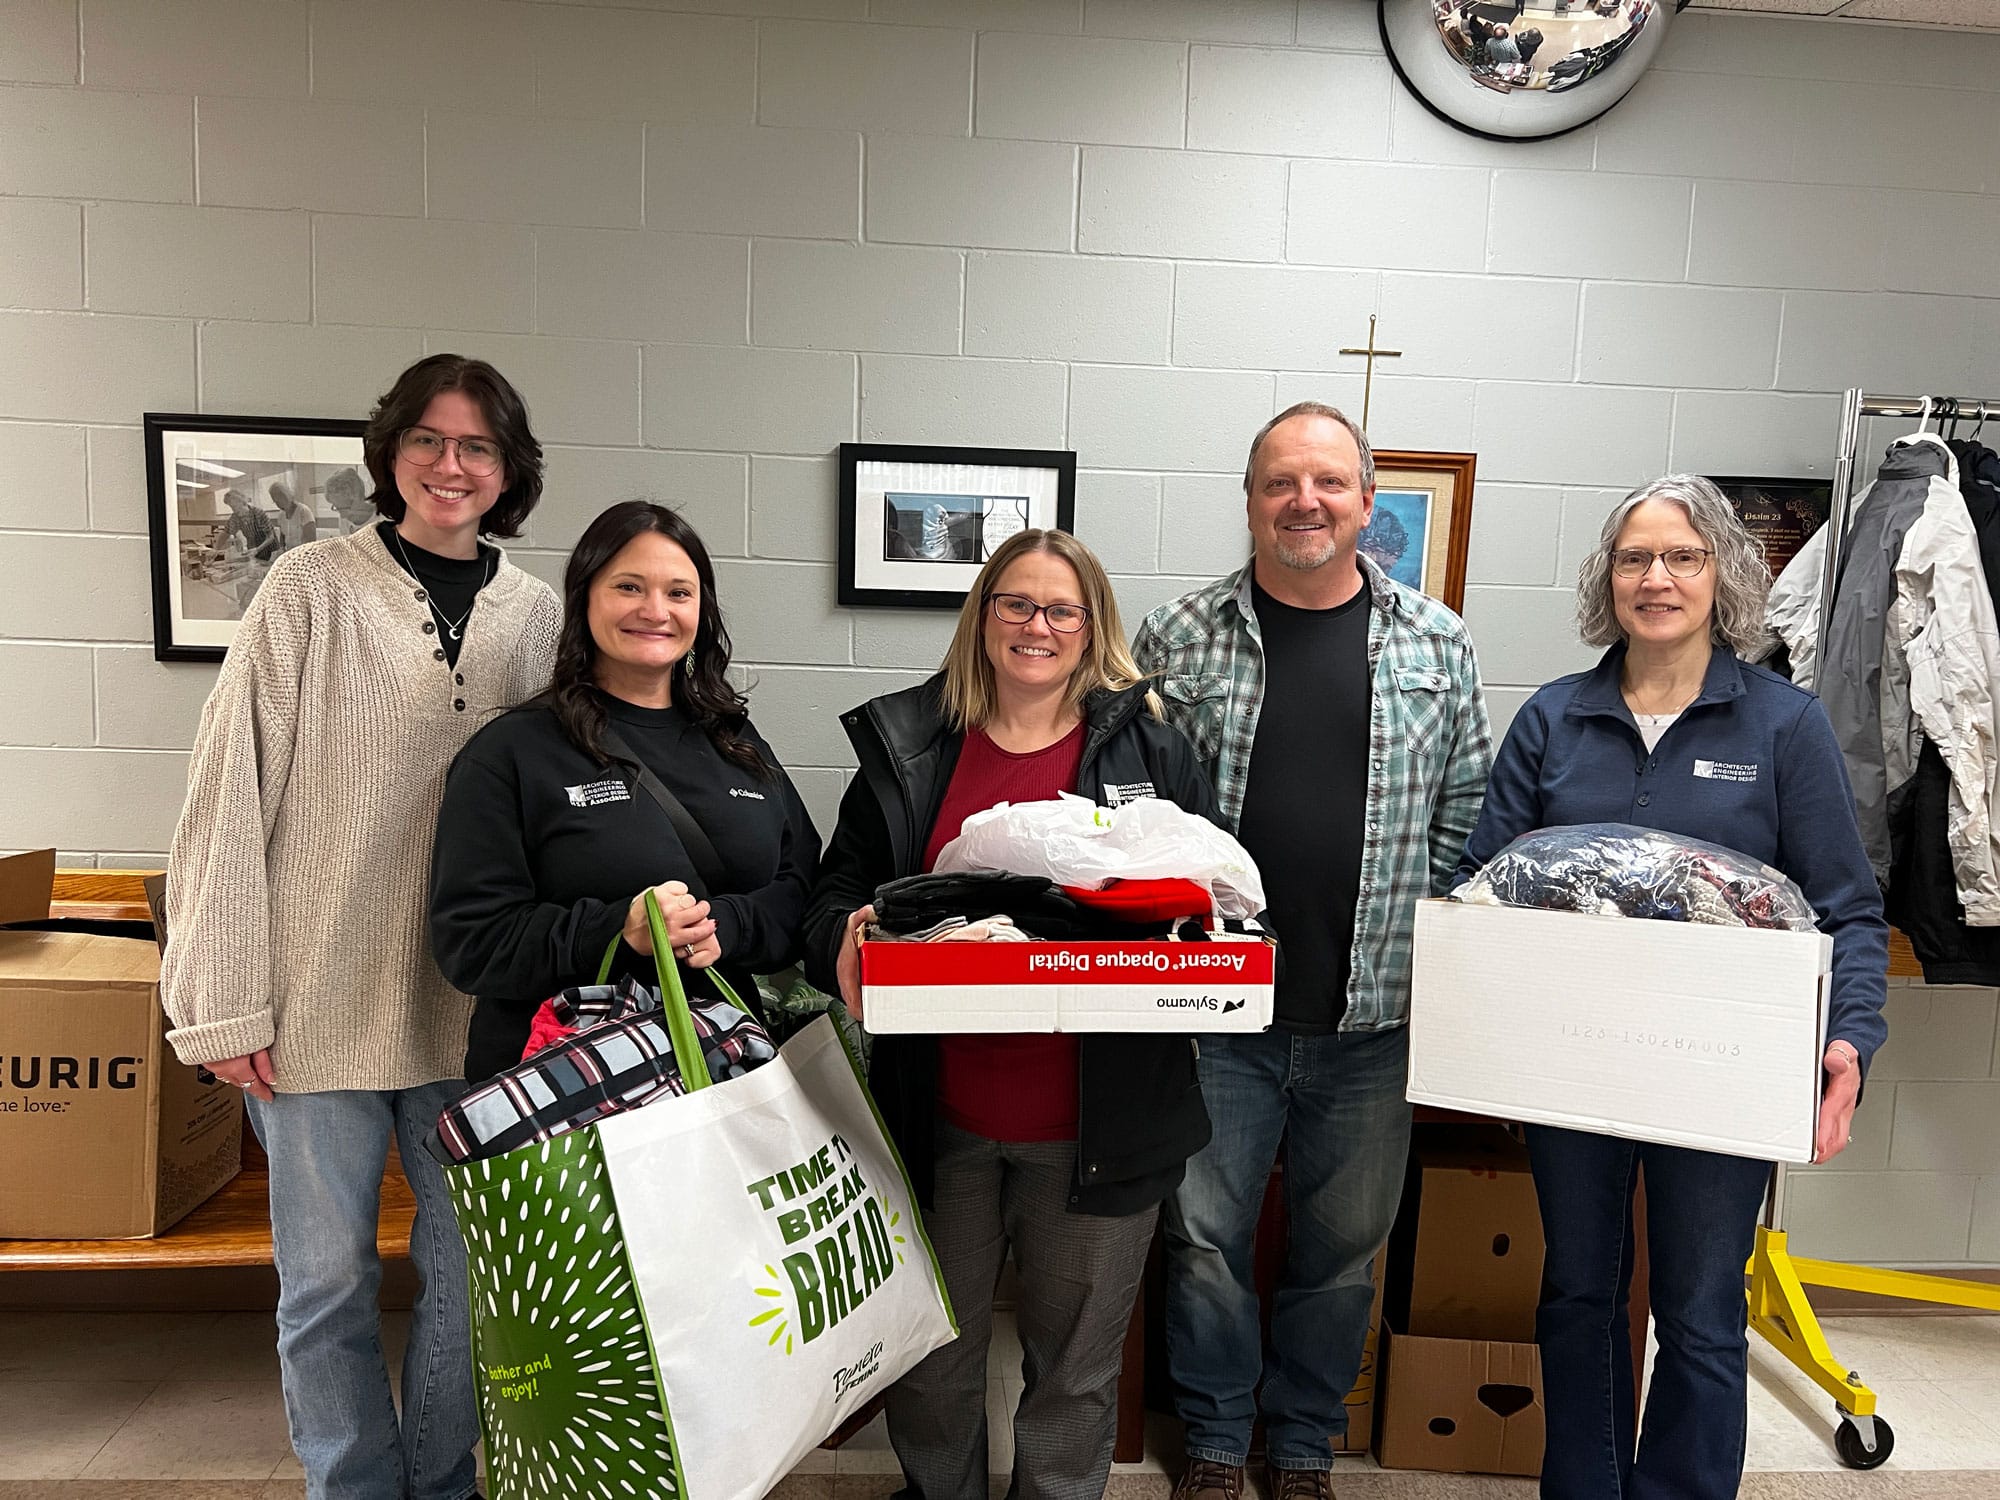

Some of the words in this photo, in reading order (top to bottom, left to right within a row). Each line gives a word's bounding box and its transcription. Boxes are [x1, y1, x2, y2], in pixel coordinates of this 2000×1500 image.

[1744, 511, 1770, 521] Psalm
[1771, 513, 1781, 521] 23
[1713, 768, 1757, 776] ENGINEERING
[1714, 762, 1758, 770] ARCHITECTURE
[1029, 951, 1090, 972] Digital
[1095, 951, 1170, 972] Opaque
[1178, 954, 1246, 972] Accent
[1156, 996, 1219, 1011] Sylvamo
[0, 1056, 137, 1090] URIG
[746, 1144, 837, 1211] TIME
[776, 1163, 868, 1246] BREAK
[781, 1196, 895, 1345] BREAD
[524, 1353, 552, 1375] and
[833, 1341, 884, 1393] Panera
[501, 1377, 539, 1402] enjoy!
